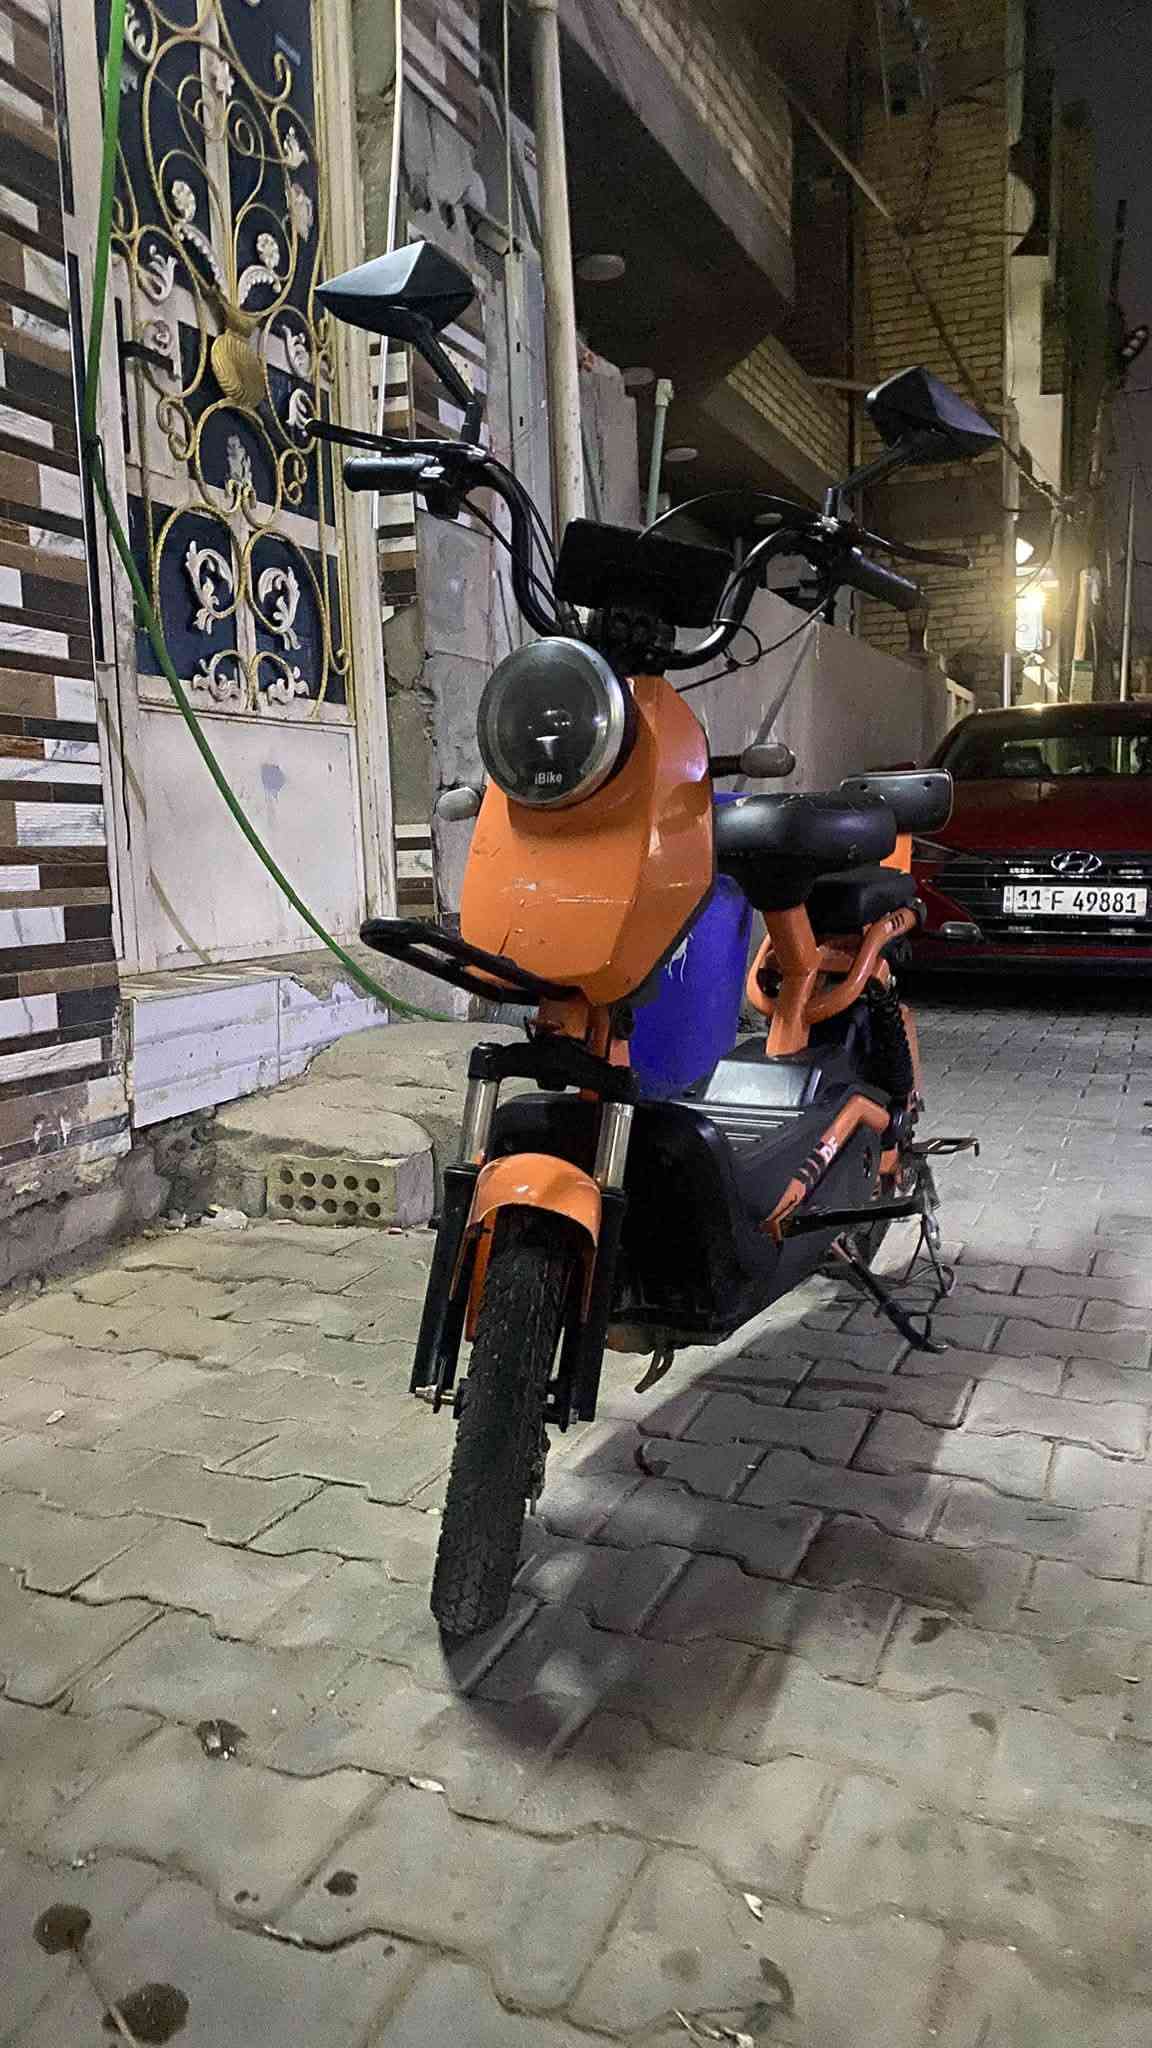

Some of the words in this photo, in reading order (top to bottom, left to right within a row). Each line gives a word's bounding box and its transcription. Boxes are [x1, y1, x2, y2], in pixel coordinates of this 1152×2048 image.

[534, 770, 563, 784] iBike
[1017, 889, 1042, 910] 11
[1051, 890, 1065, 911] F
[1072, 891, 1137, 914] 49881
